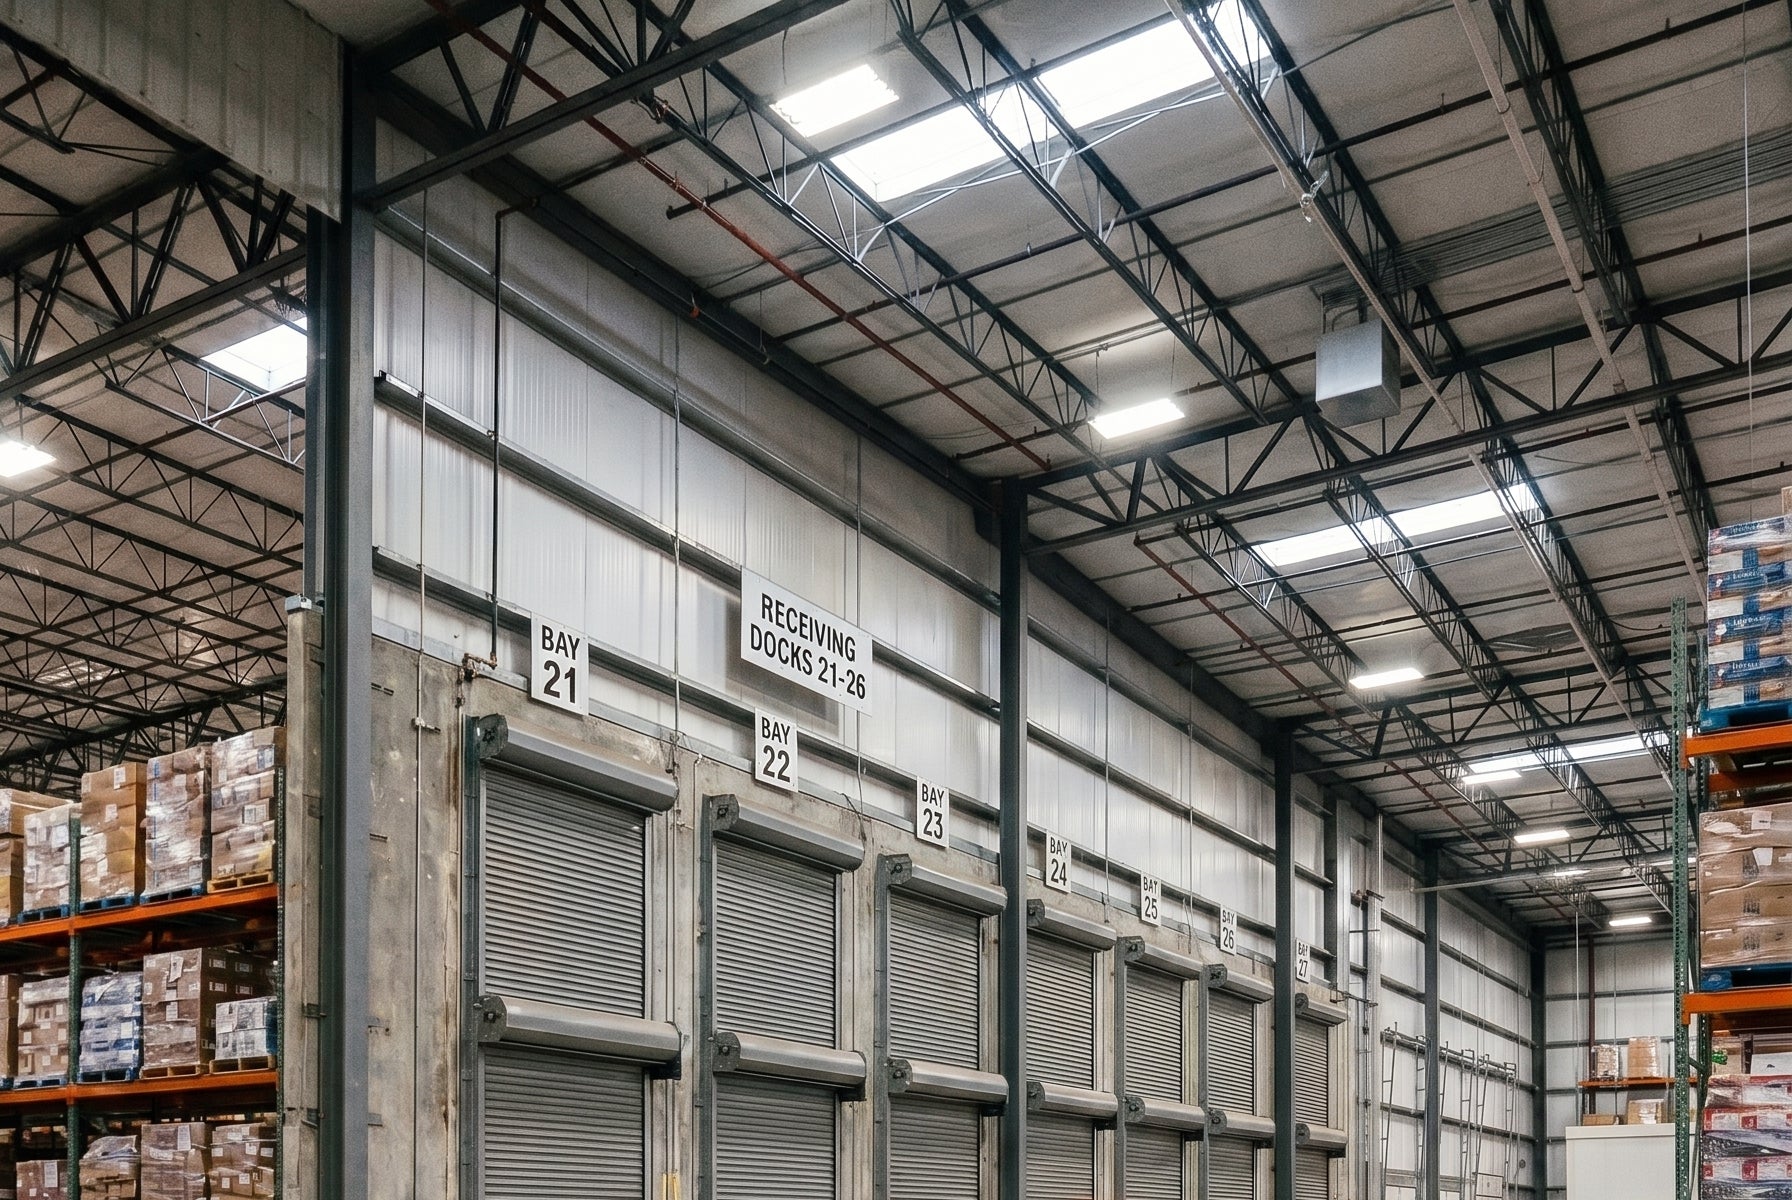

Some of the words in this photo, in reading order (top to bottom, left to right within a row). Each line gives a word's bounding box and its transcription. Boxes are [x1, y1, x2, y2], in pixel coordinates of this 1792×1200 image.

[761, 592, 856, 662] RECEIVING
[541, 624, 580, 660] BAY
[750, 622, 813, 676] DOCKS
[817, 656, 866, 700] 21-26
[543, 659, 576, 704] 21
[761, 716, 790, 745] BAY
[762, 744, 791, 783] 22
[921, 783, 945, 808] BAY
[923, 807, 943, 840] 23
[1050, 836, 1068, 857] BAY
[1050, 858, 1067, 886] 24
[1143, 876, 1158, 895] BAY
[1144, 895, 1158, 920] 25
[1222, 926, 1235, 950] 26
[1298, 958, 1308, 978] 27
